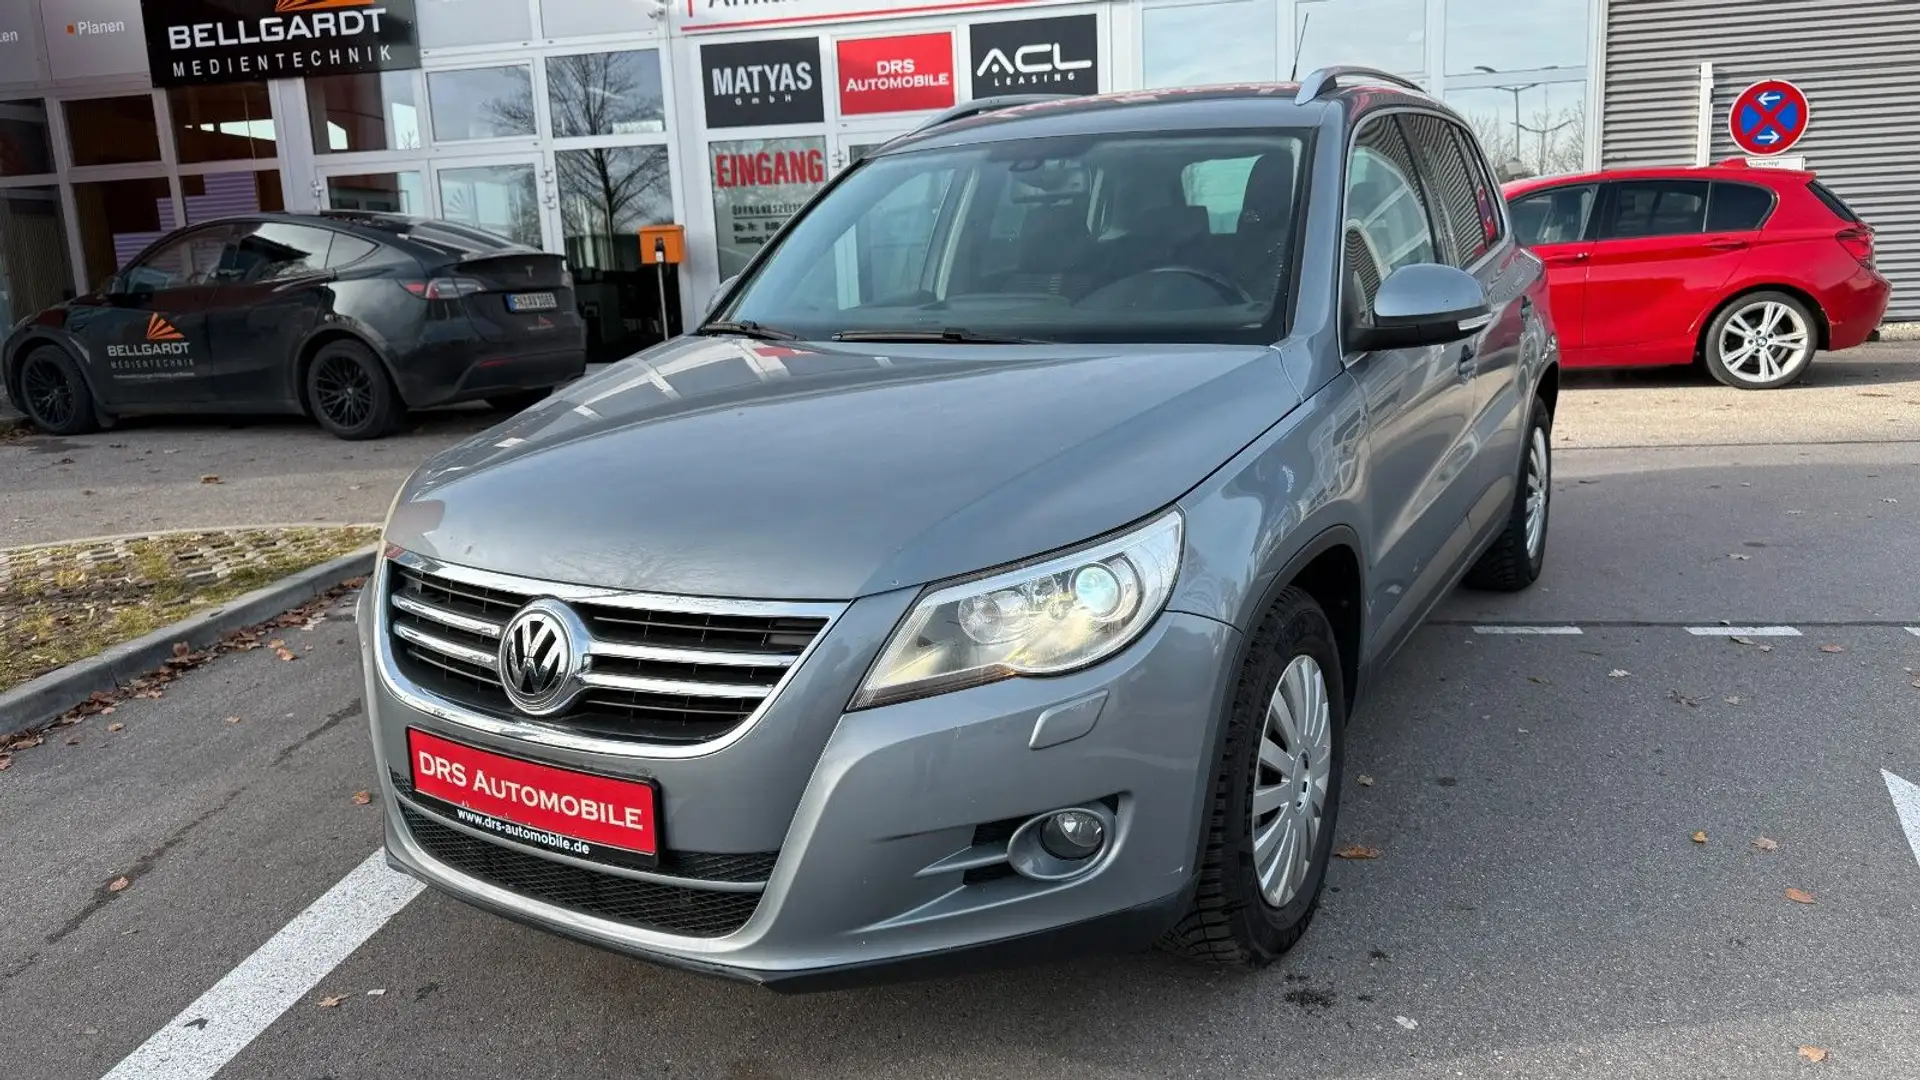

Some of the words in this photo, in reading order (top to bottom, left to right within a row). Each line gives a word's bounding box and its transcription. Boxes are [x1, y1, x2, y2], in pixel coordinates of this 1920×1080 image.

[0, 30, 18, 42] en
[78, 20, 125, 35] Planen
[168, 8, 386, 49] BELLGARDT
[172, 44, 391, 77] MEDIENTECHNIK
[876, 58, 915, 75] DRS
[976, 42, 1092, 77] ACL
[712, 61, 813, 96] MATYAS
[845, 72, 950, 92] AUTOMOBILE
[994, 71, 1075, 87] LEASING
[715, 148, 824, 188] EINGANG
[107, 342, 190, 357] BELLGARDT
[419, 750, 467, 787] DRS
[472, 770, 644, 831] AUTOMOBILE
[457, 808, 590, 855] www.drs-automobile.de
